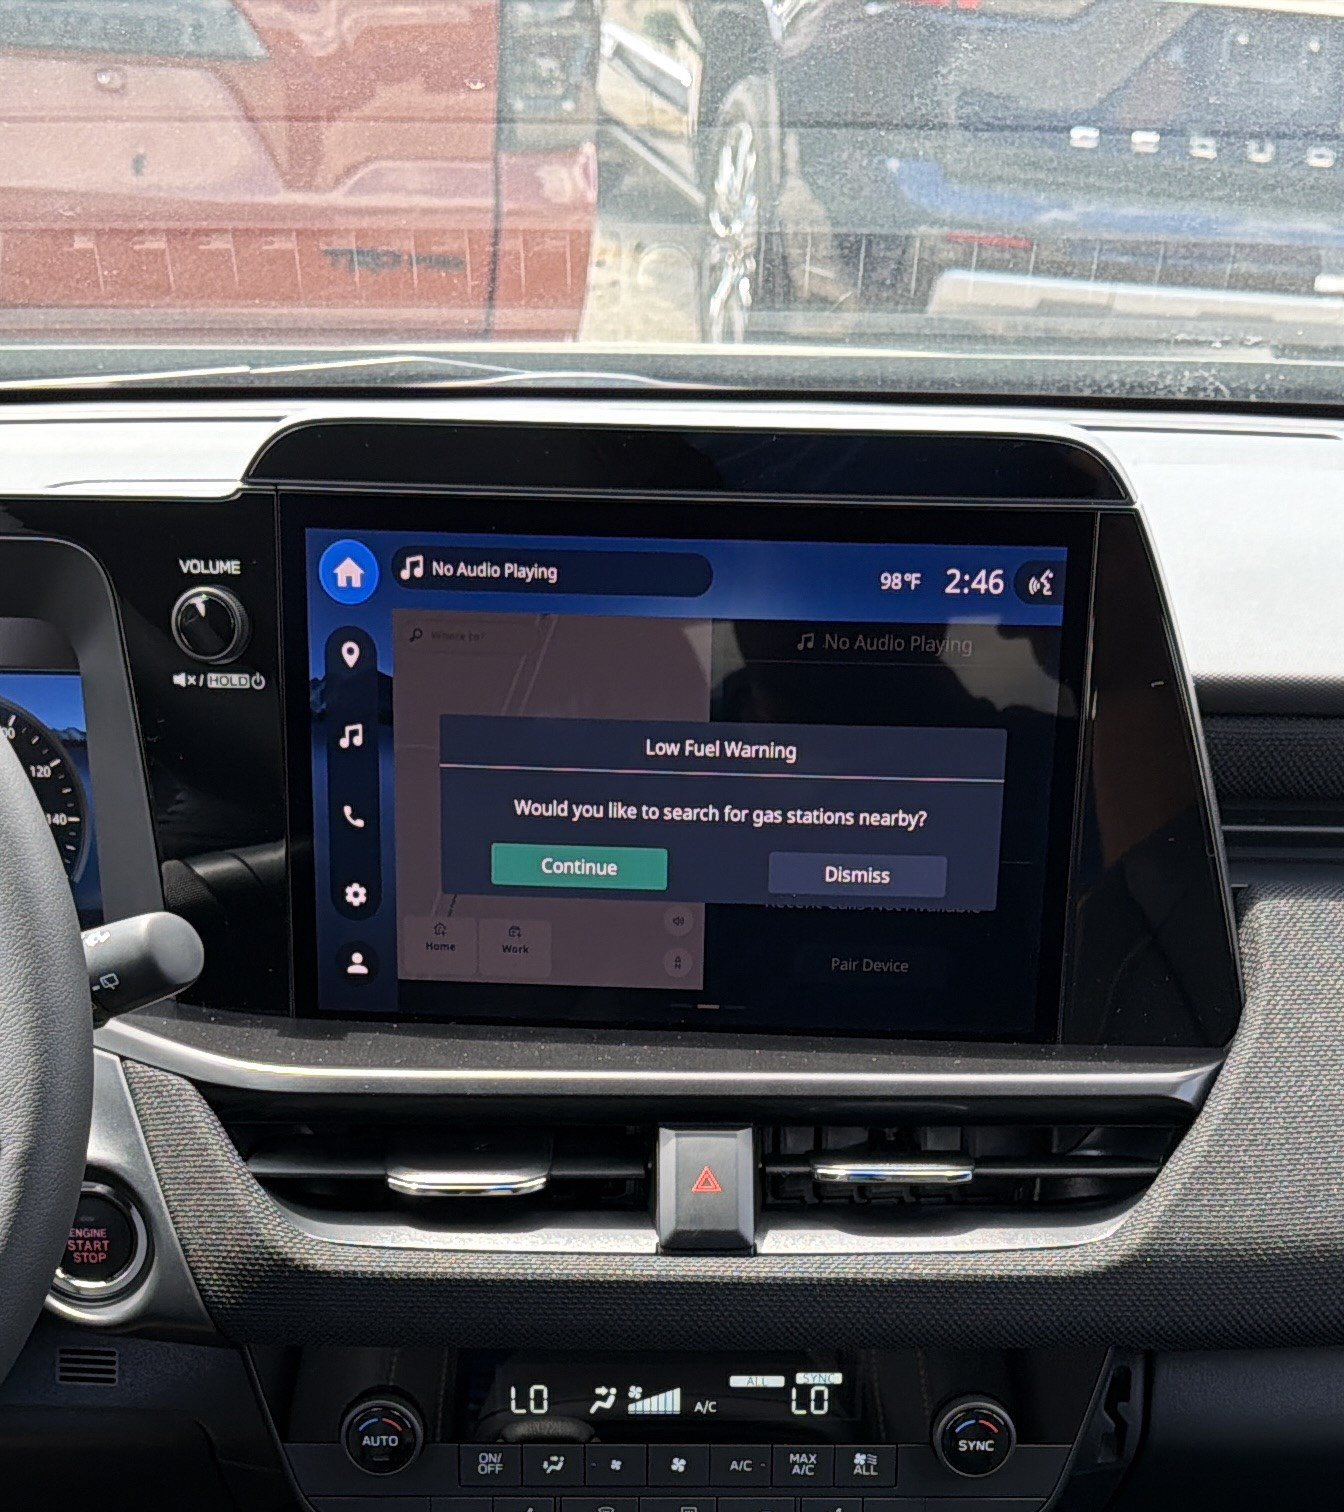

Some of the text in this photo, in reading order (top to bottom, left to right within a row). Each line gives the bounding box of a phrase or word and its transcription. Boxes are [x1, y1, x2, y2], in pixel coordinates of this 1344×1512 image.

[178, 558, 241, 575] VOLUME
[432, 561, 558, 584] No Audio Playing
[880, 572, 922, 591] 98°F
[944, 568, 1005, 595] 2:46
[824, 633, 973, 657] No Audio Playing
[209, 676, 248, 687] HOLD
[645, 738, 797, 764] Low Fuel Warning
[30, 766, 52, 778] 120
[46, 812, 68, 826] 140
[513, 799, 928, 831] Would you like to search for gas stations nearby?
[541, 857, 619, 877] Continue
[824, 865, 891, 885] Dismiss
[425, 941, 456, 952] Home
[502, 943, 529, 954] Work
[831, 957, 909, 973] Pair Device
[69, 1228, 107, 1238] ENGINE
[68, 1240, 110, 1251] START
[73, 1252, 107, 1263] STOP
[510, 1384, 548, 1414] LO
[791, 1385, 829, 1415] LO
[694, 1401, 717, 1414] A/C
[361, 1435, 399, 1447] AUTO
[958, 1440, 995, 1452] SYNC
[478, 1452, 503, 1464] ON/
[789, 1453, 817, 1464] MAX
[477, 1463, 504, 1475] OFF
[729, 1460, 753, 1472] A/C
[791, 1464, 815, 1476] A/C
[853, 1464, 878, 1476] ALL
